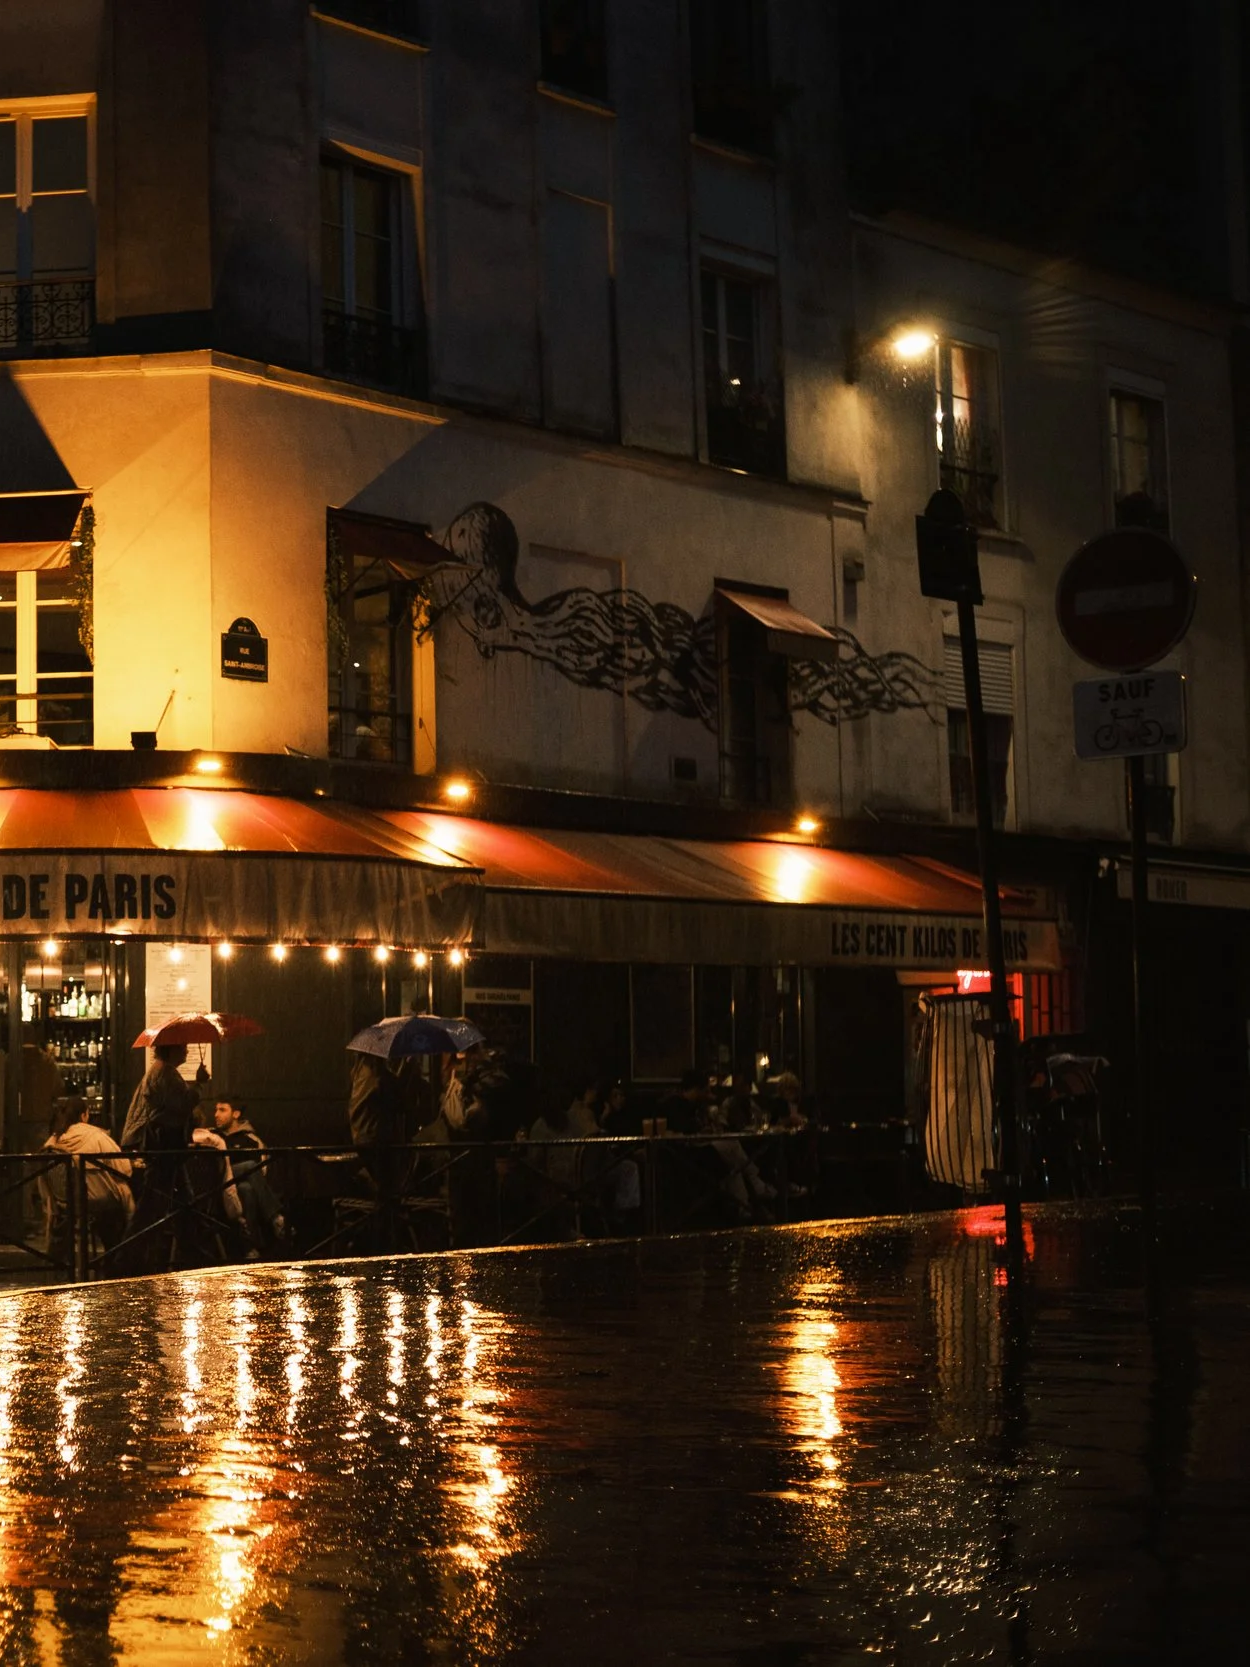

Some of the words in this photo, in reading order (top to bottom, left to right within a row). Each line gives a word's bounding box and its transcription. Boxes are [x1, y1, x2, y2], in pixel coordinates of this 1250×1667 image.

[1098, 679, 1155, 702] SAUF
[3, 874, 50, 920] DE
[65, 873, 177, 920] PARIS
[831, 923, 860, 955] LES
[866, 924, 906, 957] CENT
[913, 926, 957, 958] KILOS
[962, 927, 981, 958] DE
[1003, 929, 1028, 961] RIS
